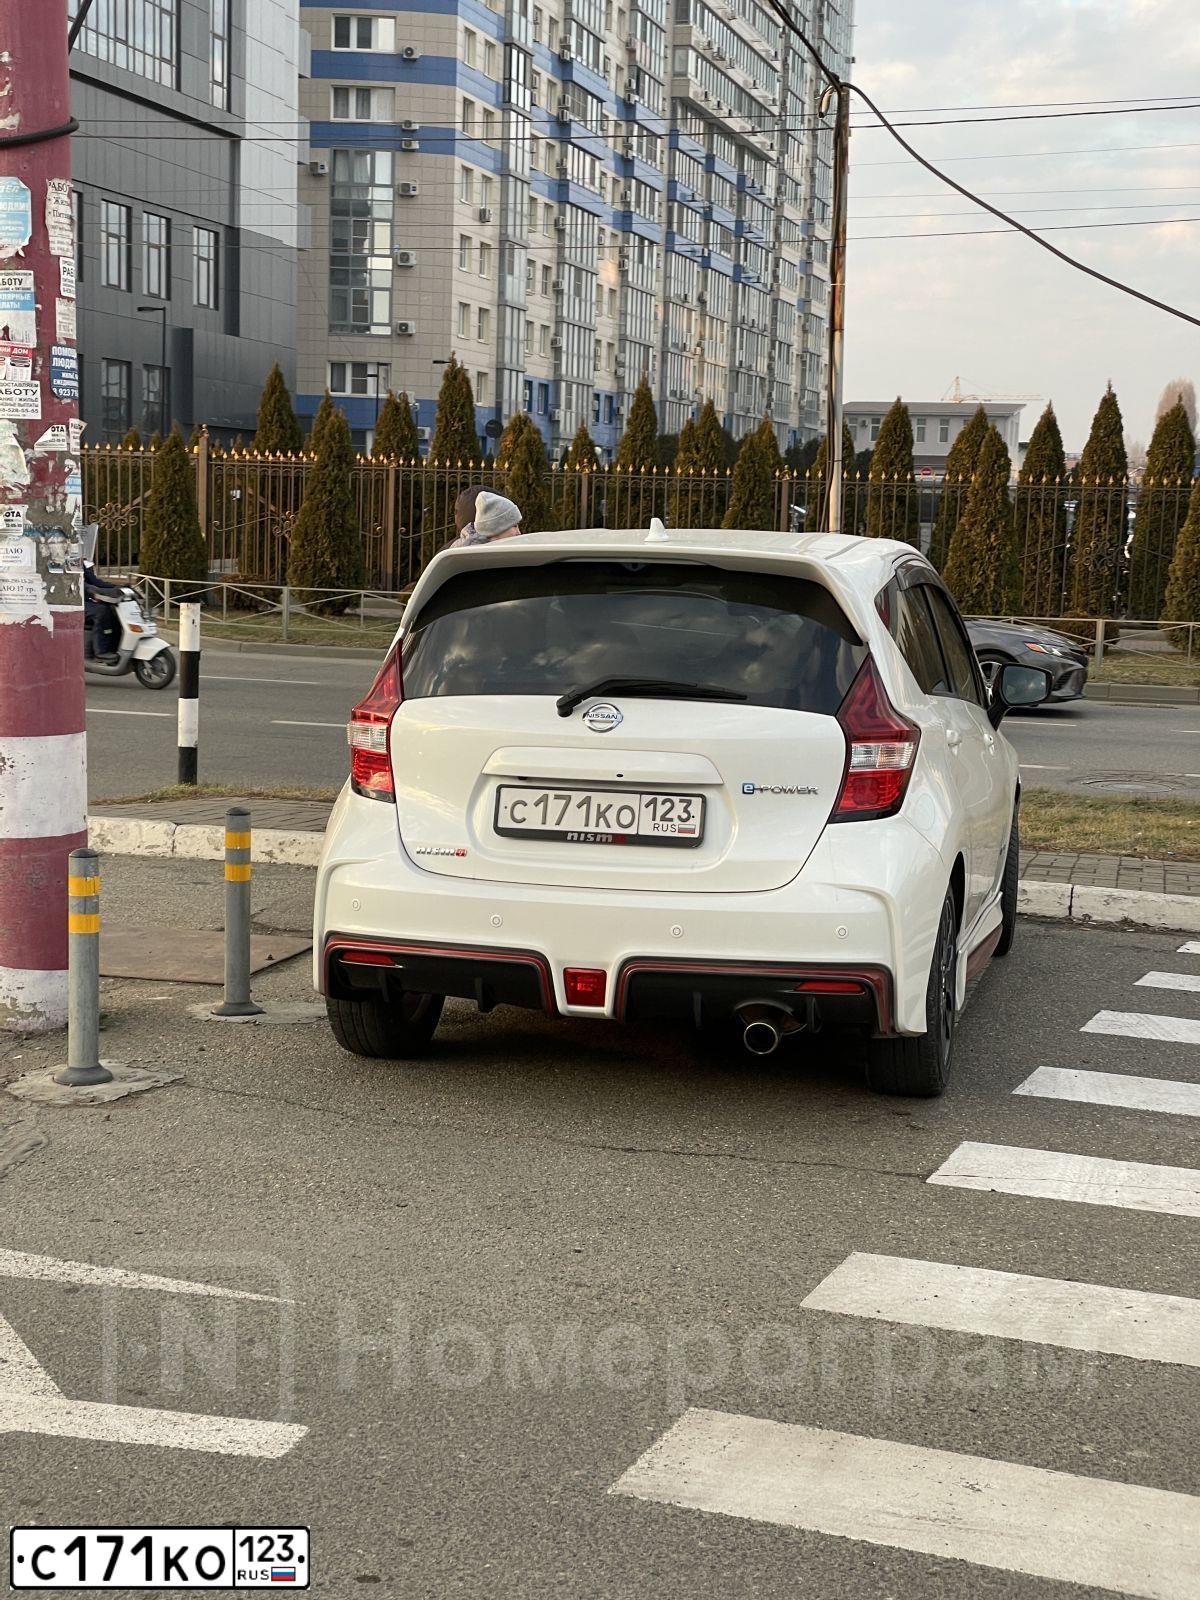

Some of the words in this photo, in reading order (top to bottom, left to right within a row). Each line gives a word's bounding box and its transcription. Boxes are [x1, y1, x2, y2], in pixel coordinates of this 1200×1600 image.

[0, 278, 23, 286] БОТУ
[585, 712, 619, 720] NISSAN
[644, 797, 692, 823] 123
[652, 822, 677, 833] RUS
